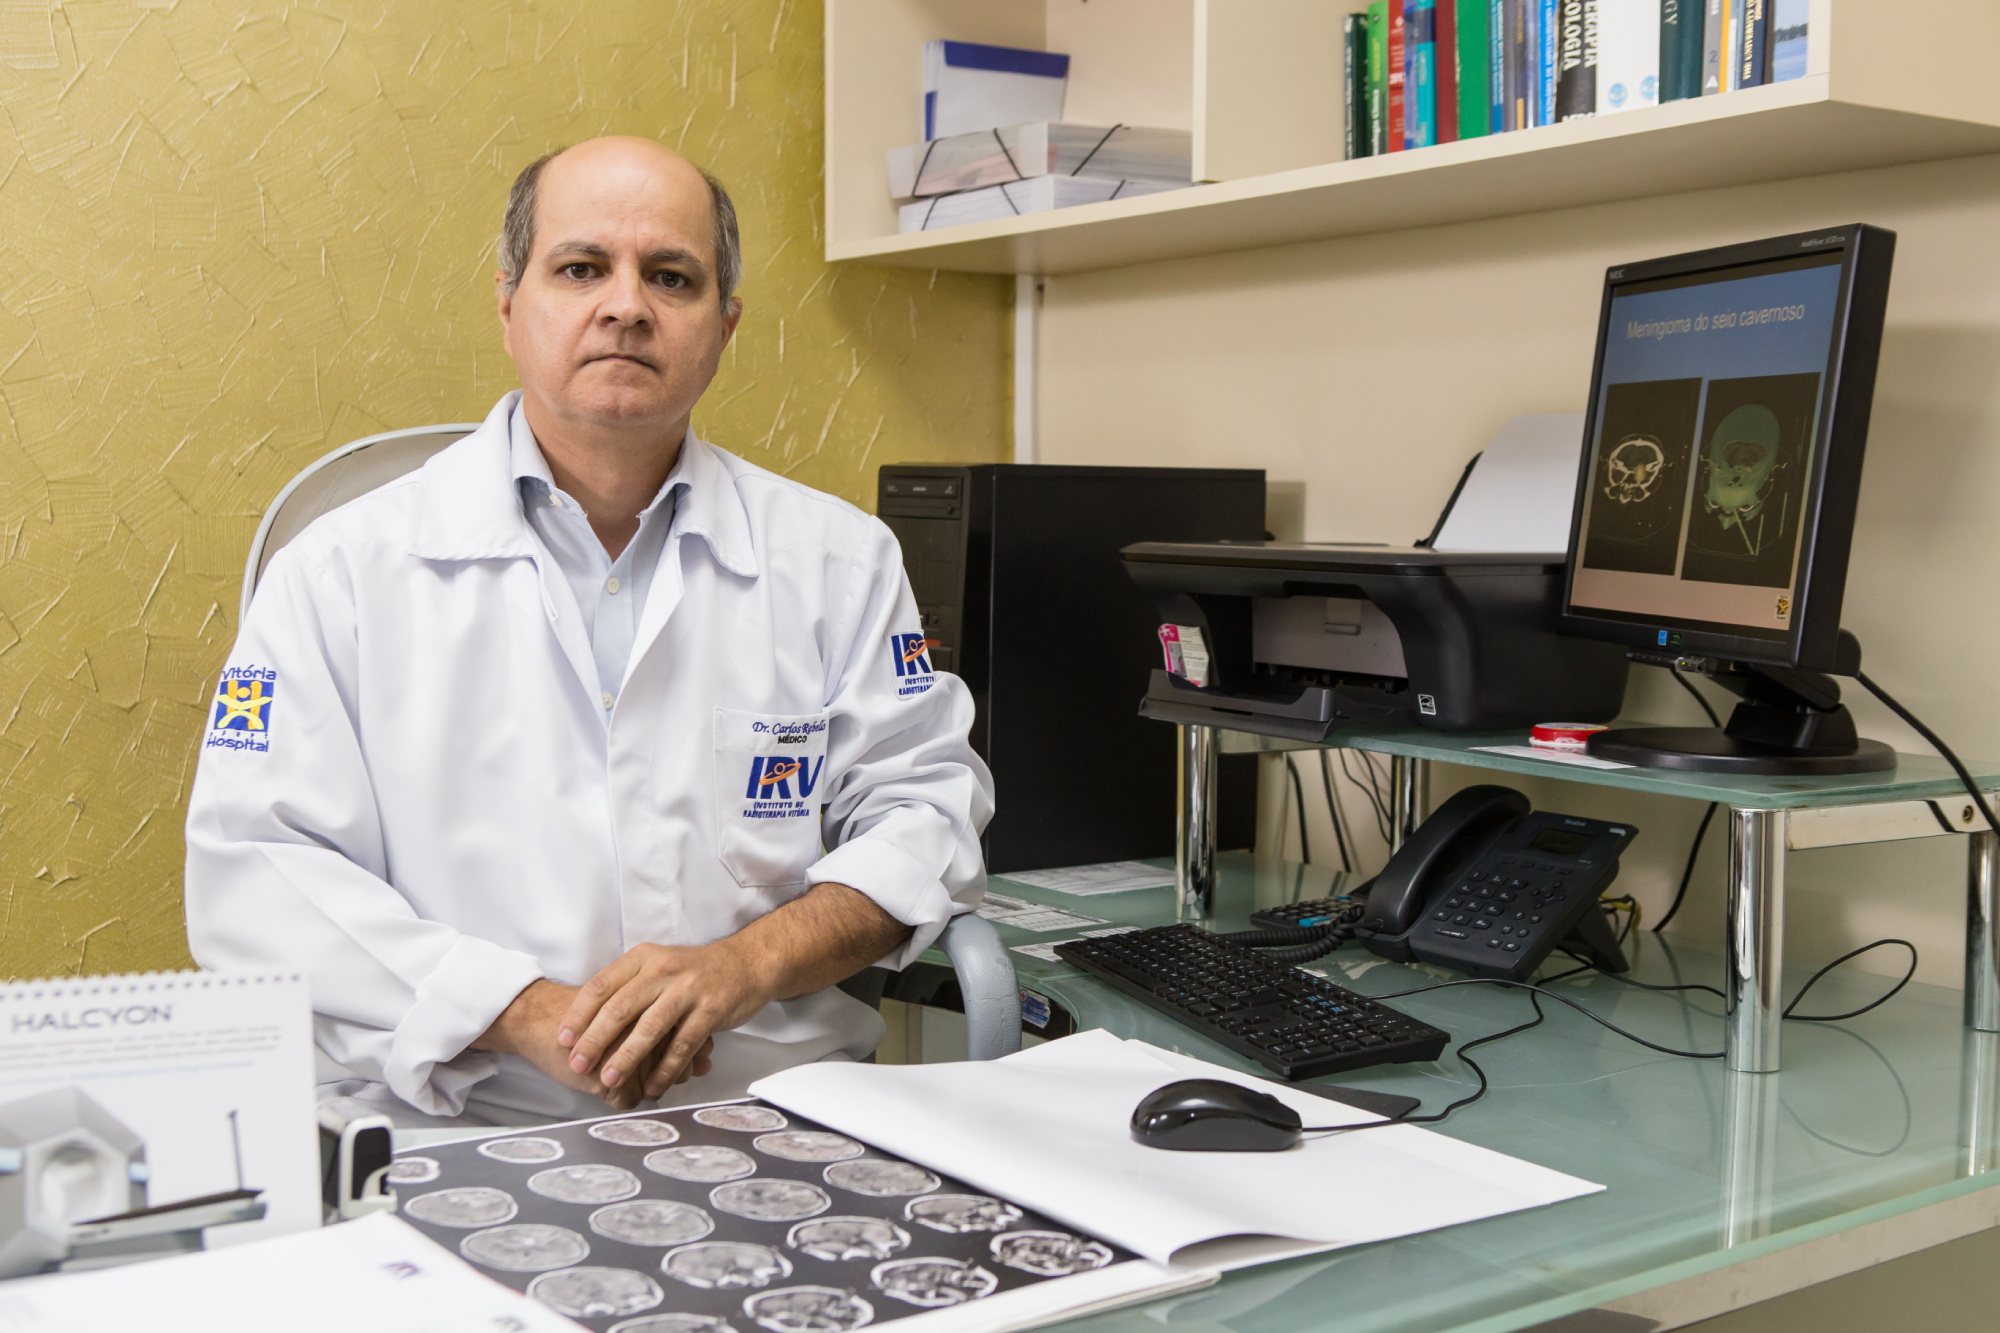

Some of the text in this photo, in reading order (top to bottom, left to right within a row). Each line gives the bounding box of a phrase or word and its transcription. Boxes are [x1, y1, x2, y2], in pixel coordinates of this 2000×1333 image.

[1708, 50, 1718, 63] 2
[1609, 268, 1626, 280] NEC
[1627, 303, 1805, 341] Meningioma do seio cavernoso
[890, 633, 932, 677] IR
[752, 721, 770, 734] Dr.
[772, 722, 801, 735] Carlos
[206, 736, 270, 753] Hospital
[777, 734, 808, 744] MÉDICO
[746, 755, 825, 800] IRV
[753, 801, 793, 809] INSTITUTO
[743, 807, 810, 819] RADIOTERAPIA VITÓRIA
[11, 1003, 173, 1033] HALCYON
